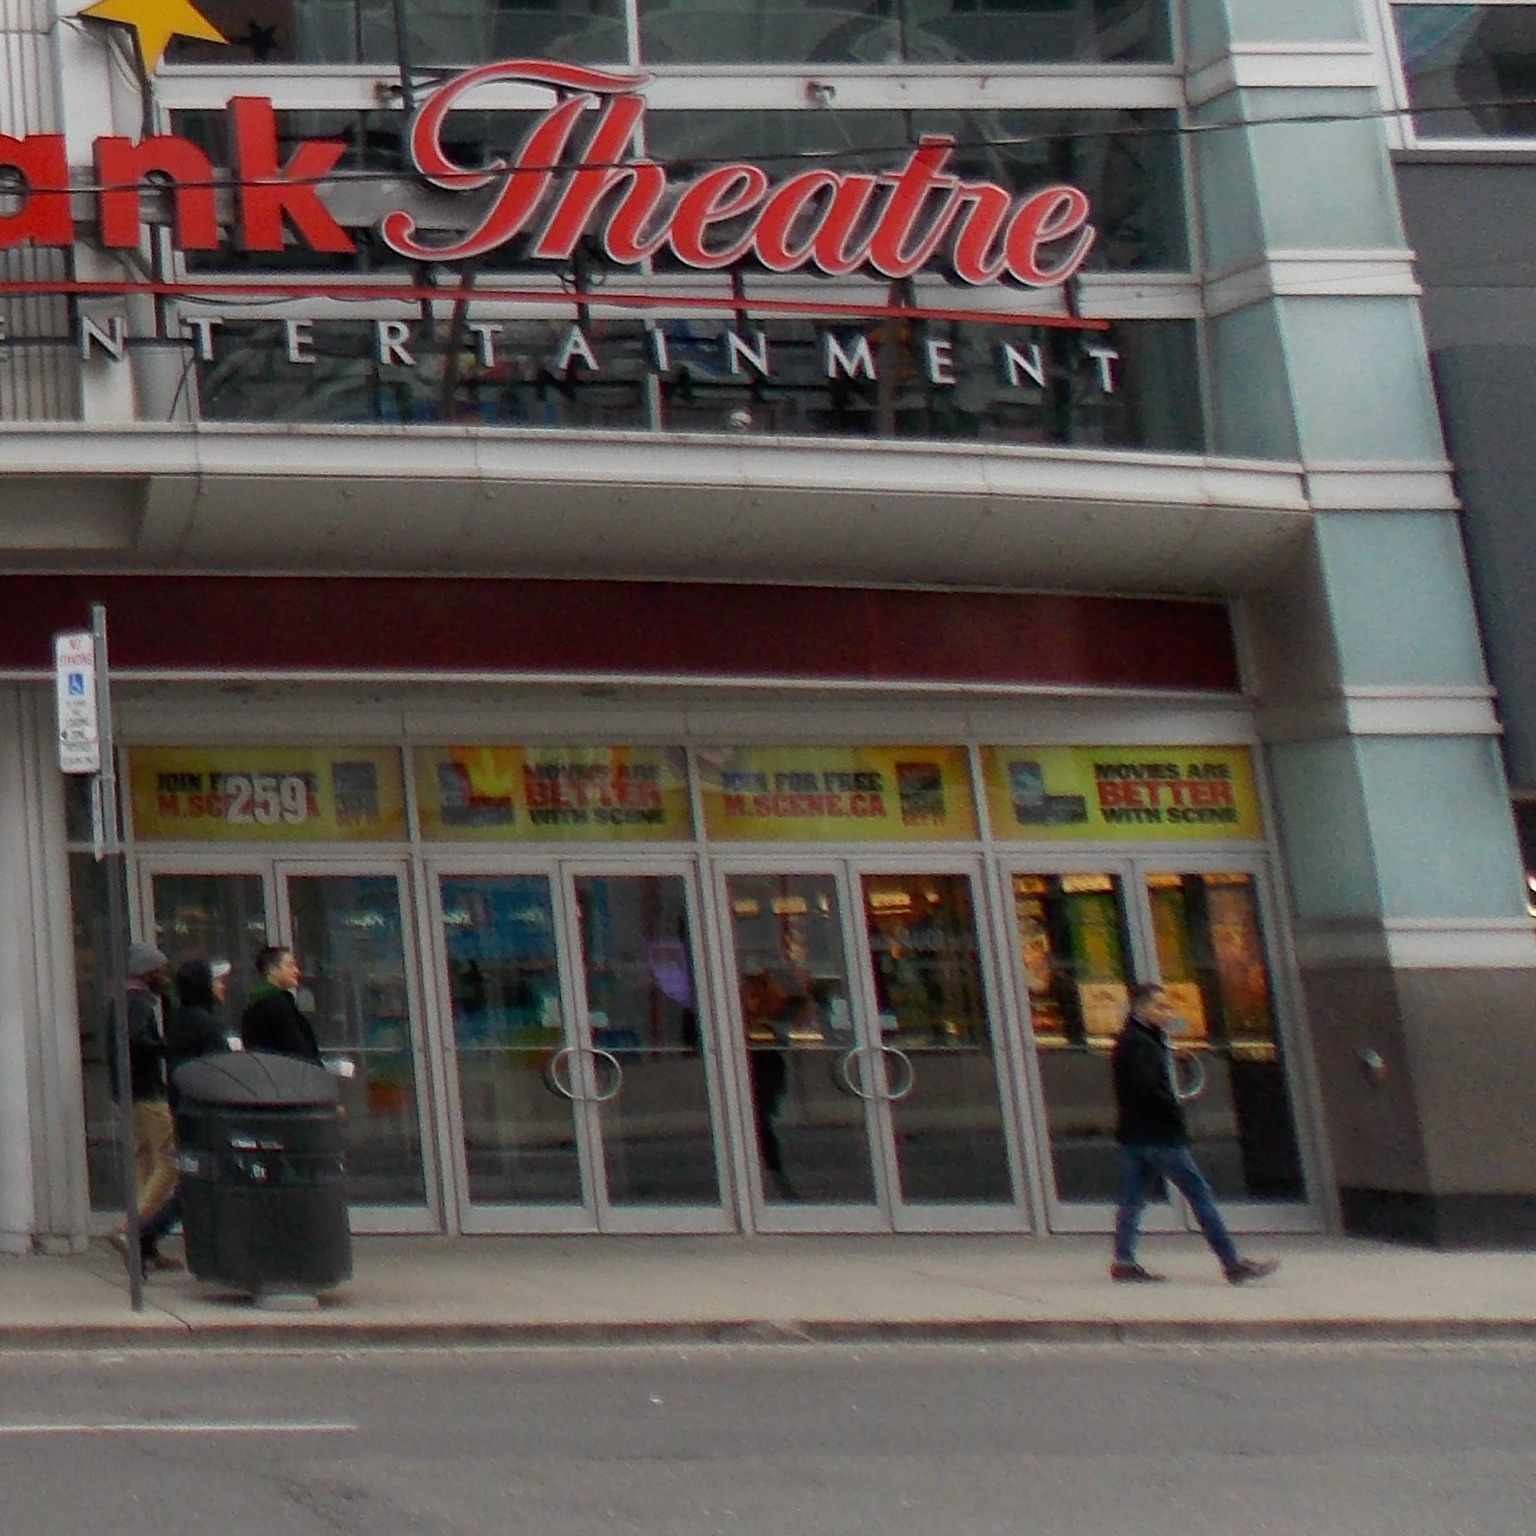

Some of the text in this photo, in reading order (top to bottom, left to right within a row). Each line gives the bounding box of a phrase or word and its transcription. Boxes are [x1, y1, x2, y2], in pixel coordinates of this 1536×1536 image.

[383, 59, 1096, 289] Theatre
[1095, 763, 1232, 779] MOVIES ARE
[225, 775, 308, 825] 259
[1097, 780, 1235, 807] BETTER
[1101, 807, 1238, 824] WITH SCENE
